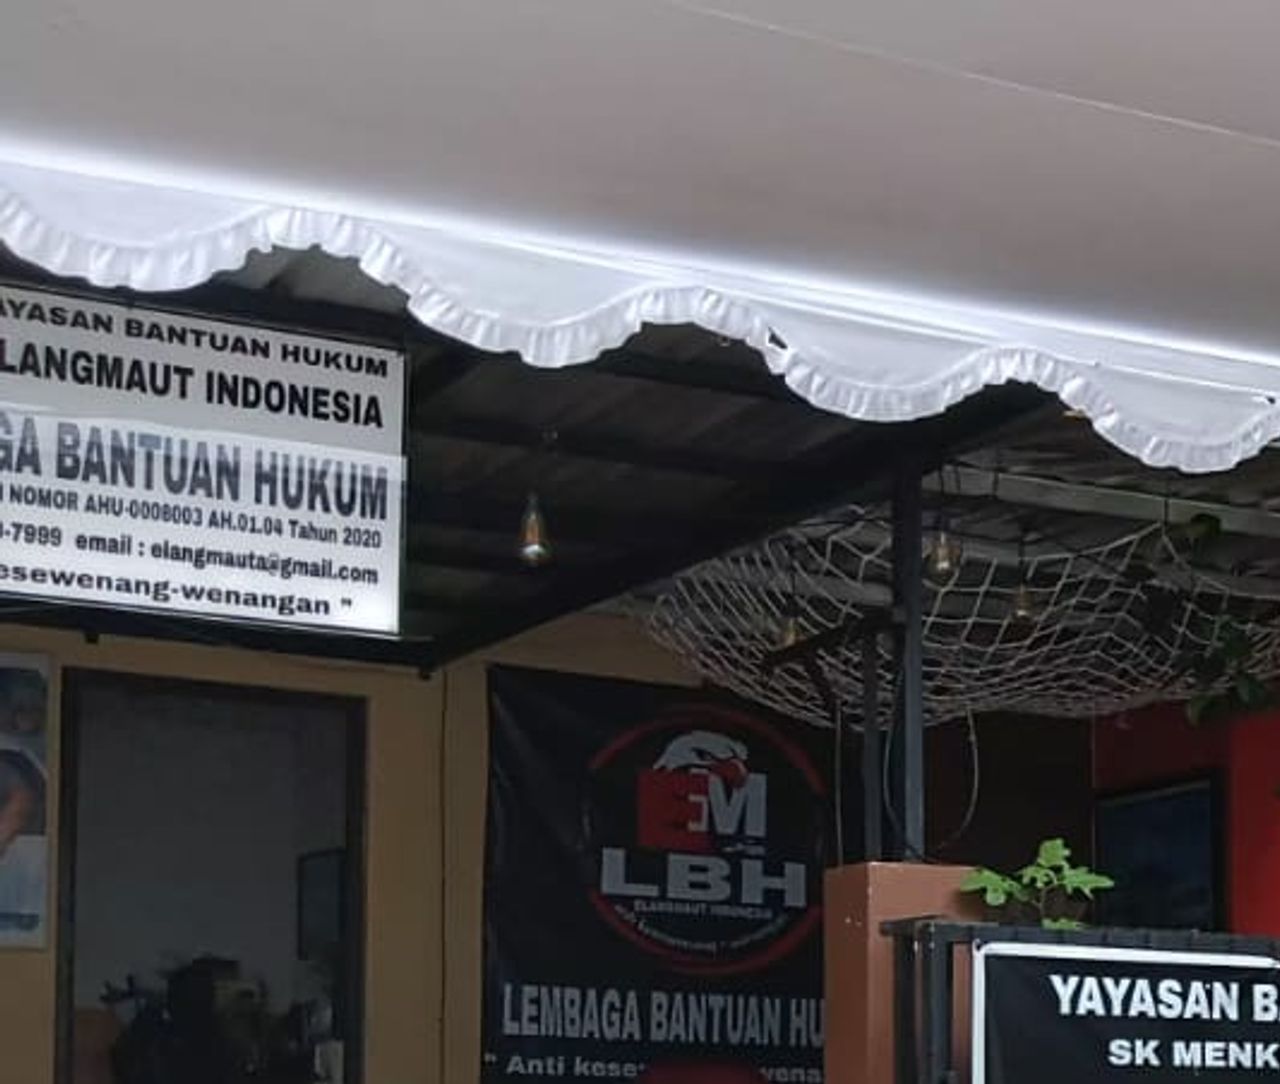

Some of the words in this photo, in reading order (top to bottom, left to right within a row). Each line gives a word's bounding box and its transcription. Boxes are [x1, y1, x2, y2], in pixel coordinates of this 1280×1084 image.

[125, 317, 270, 359] BANTUAN
[281, 343, 388, 378] HUKUM
[0, 337, 194, 400] LANGMAUT
[206, 370, 384, 429] INDONESIA
[56, 421, 240, 502] BANTUAN
[255, 448, 388, 520] HUKUM
[0, 520, 62, 547] -7999
[75, 533, 132, 557] email
[10, 484, 79, 511] NOMOR
[289, 519, 338, 544] Tahun
[343, 527, 382, 549] 2020
[601, 846, 807, 908] LBH
[502, 982, 642, 1042] LEMBAGA
[650, 990, 782, 1047] BANTUAN
[1049, 974, 1240, 1022] YAYASAN
[506, 1053, 566, 1077] Anti
[1108, 1038, 1161, 1067] SK
